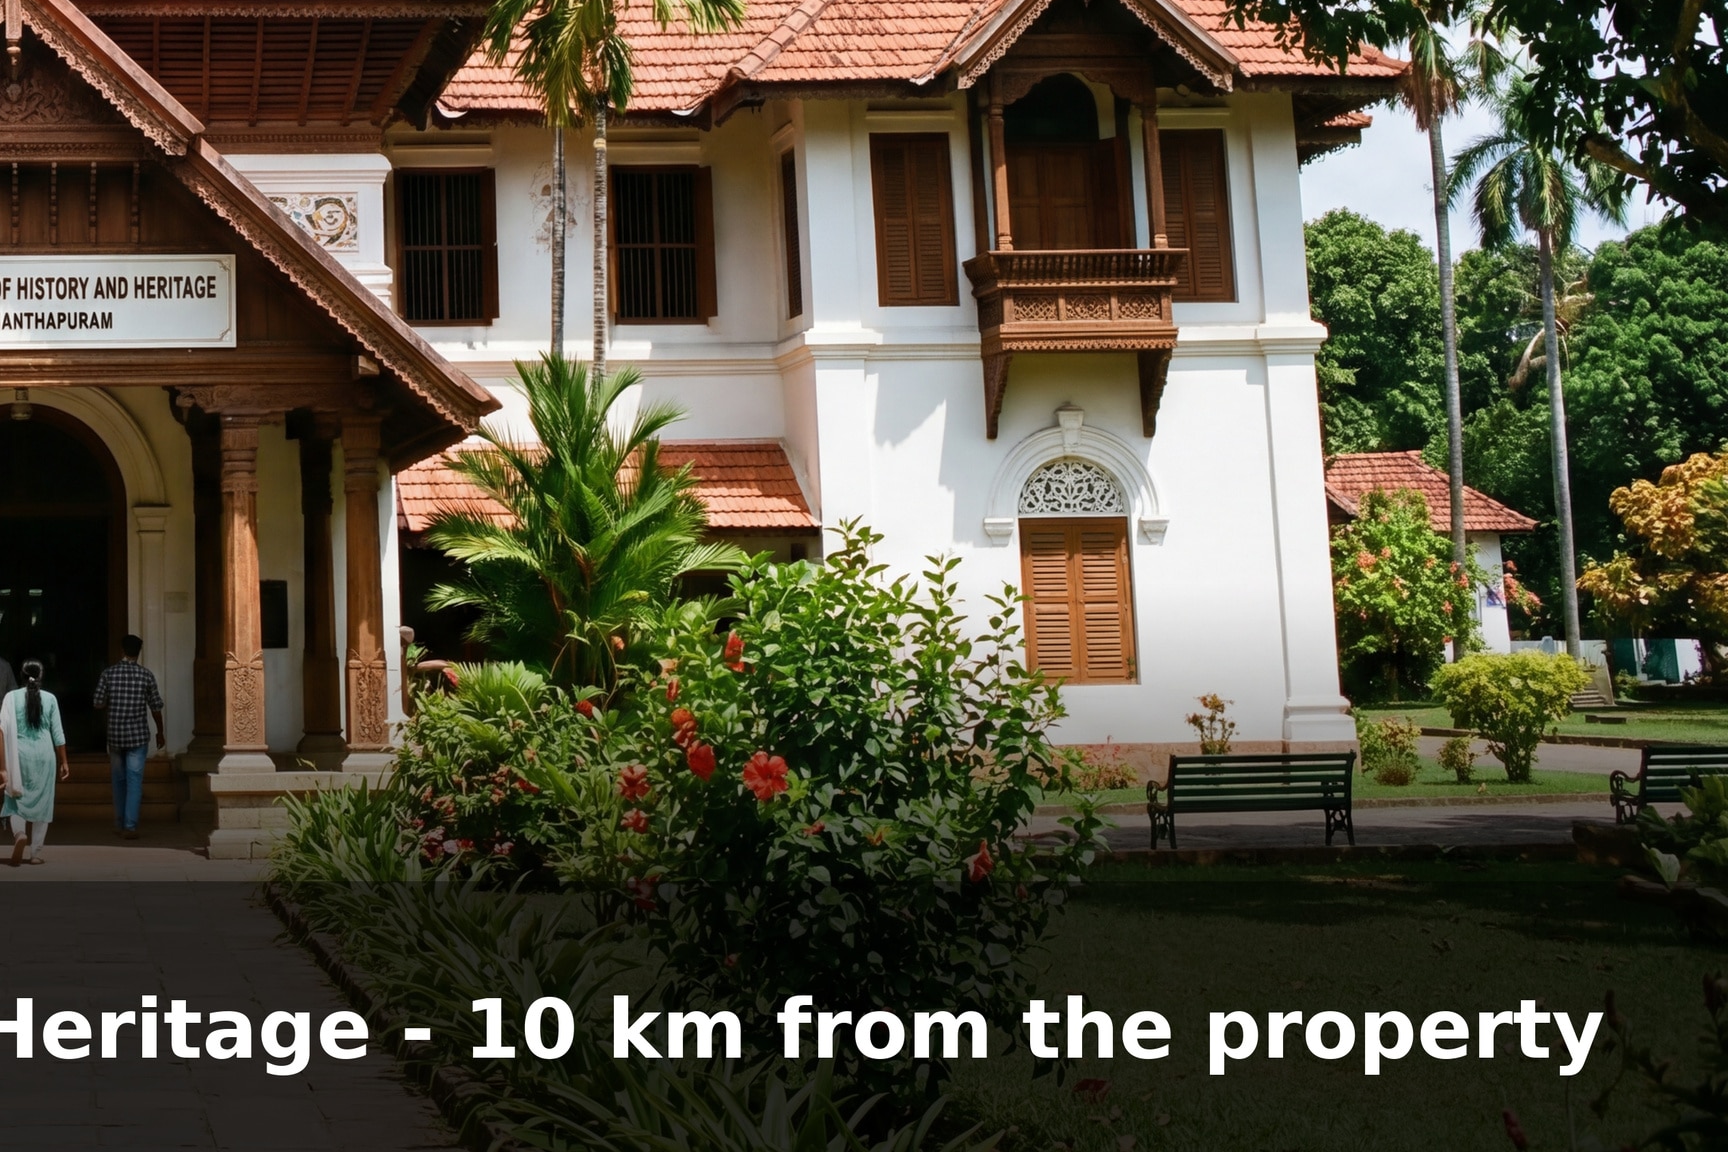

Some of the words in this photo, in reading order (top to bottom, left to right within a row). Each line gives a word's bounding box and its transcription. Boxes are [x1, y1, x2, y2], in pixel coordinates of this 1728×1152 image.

[17, 276, 90, 301] HISTORY
[93, 276, 129, 300] AND
[134, 275, 217, 299] HERITAGE
